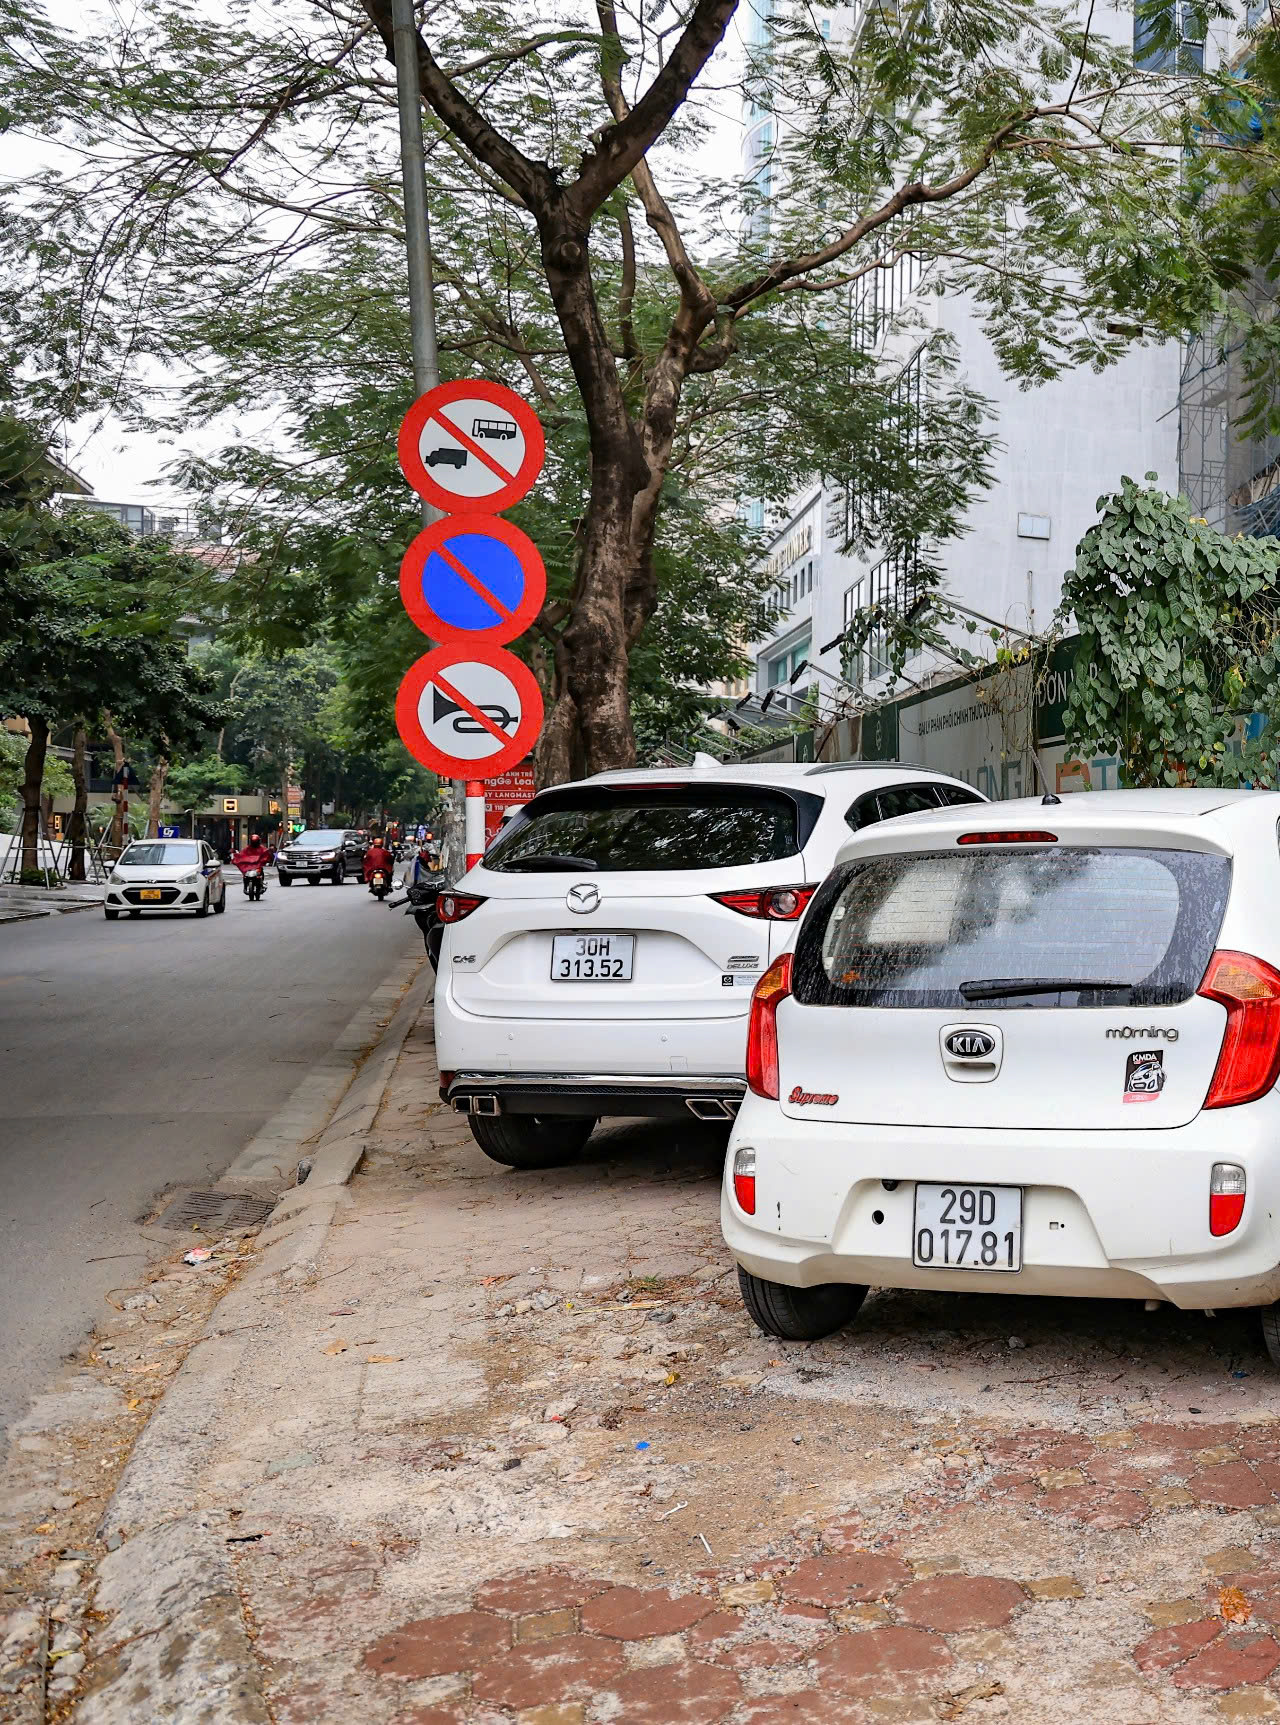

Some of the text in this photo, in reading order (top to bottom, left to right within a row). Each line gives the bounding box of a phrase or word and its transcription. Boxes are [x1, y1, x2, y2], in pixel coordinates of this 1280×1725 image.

[484, 777, 512, 787] ngGo
[575, 937, 611, 956] 30H
[560, 959, 624, 978] 313.52
[952, 1037, 986, 1053] KIA
[1132, 1053, 1158, 1063] KMDA
[939, 1189, 996, 1226] 29D
[917, 1228, 1014, 1268] 017.81
